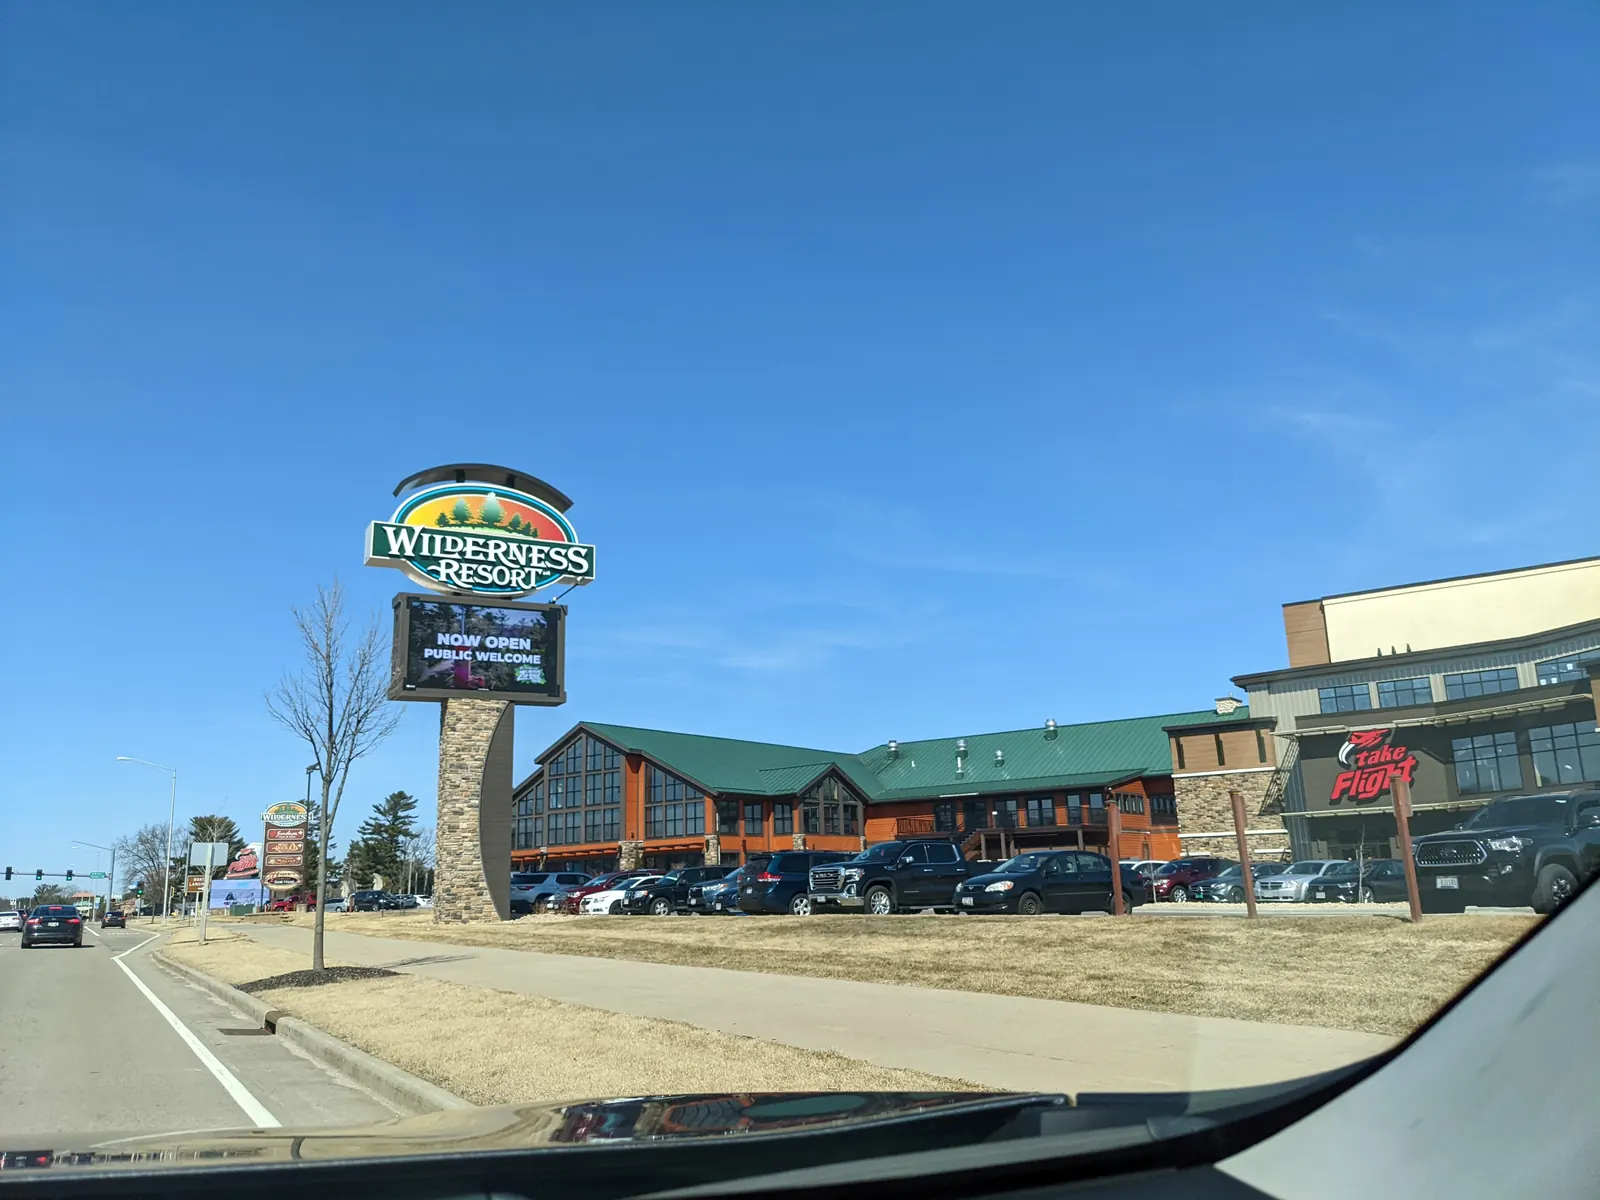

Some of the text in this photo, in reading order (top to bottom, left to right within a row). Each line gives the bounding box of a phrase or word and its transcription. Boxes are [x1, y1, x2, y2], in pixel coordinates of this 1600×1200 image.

[382, 525, 589, 574] WILDERNESS
[427, 559, 543, 589] RESORT
[437, 632, 531, 650] NOW OPEN
[424, 648, 541, 664] PUBLIC WELCOME
[1356, 744, 1406, 766] take
[1331, 755, 1416, 799] Flight
